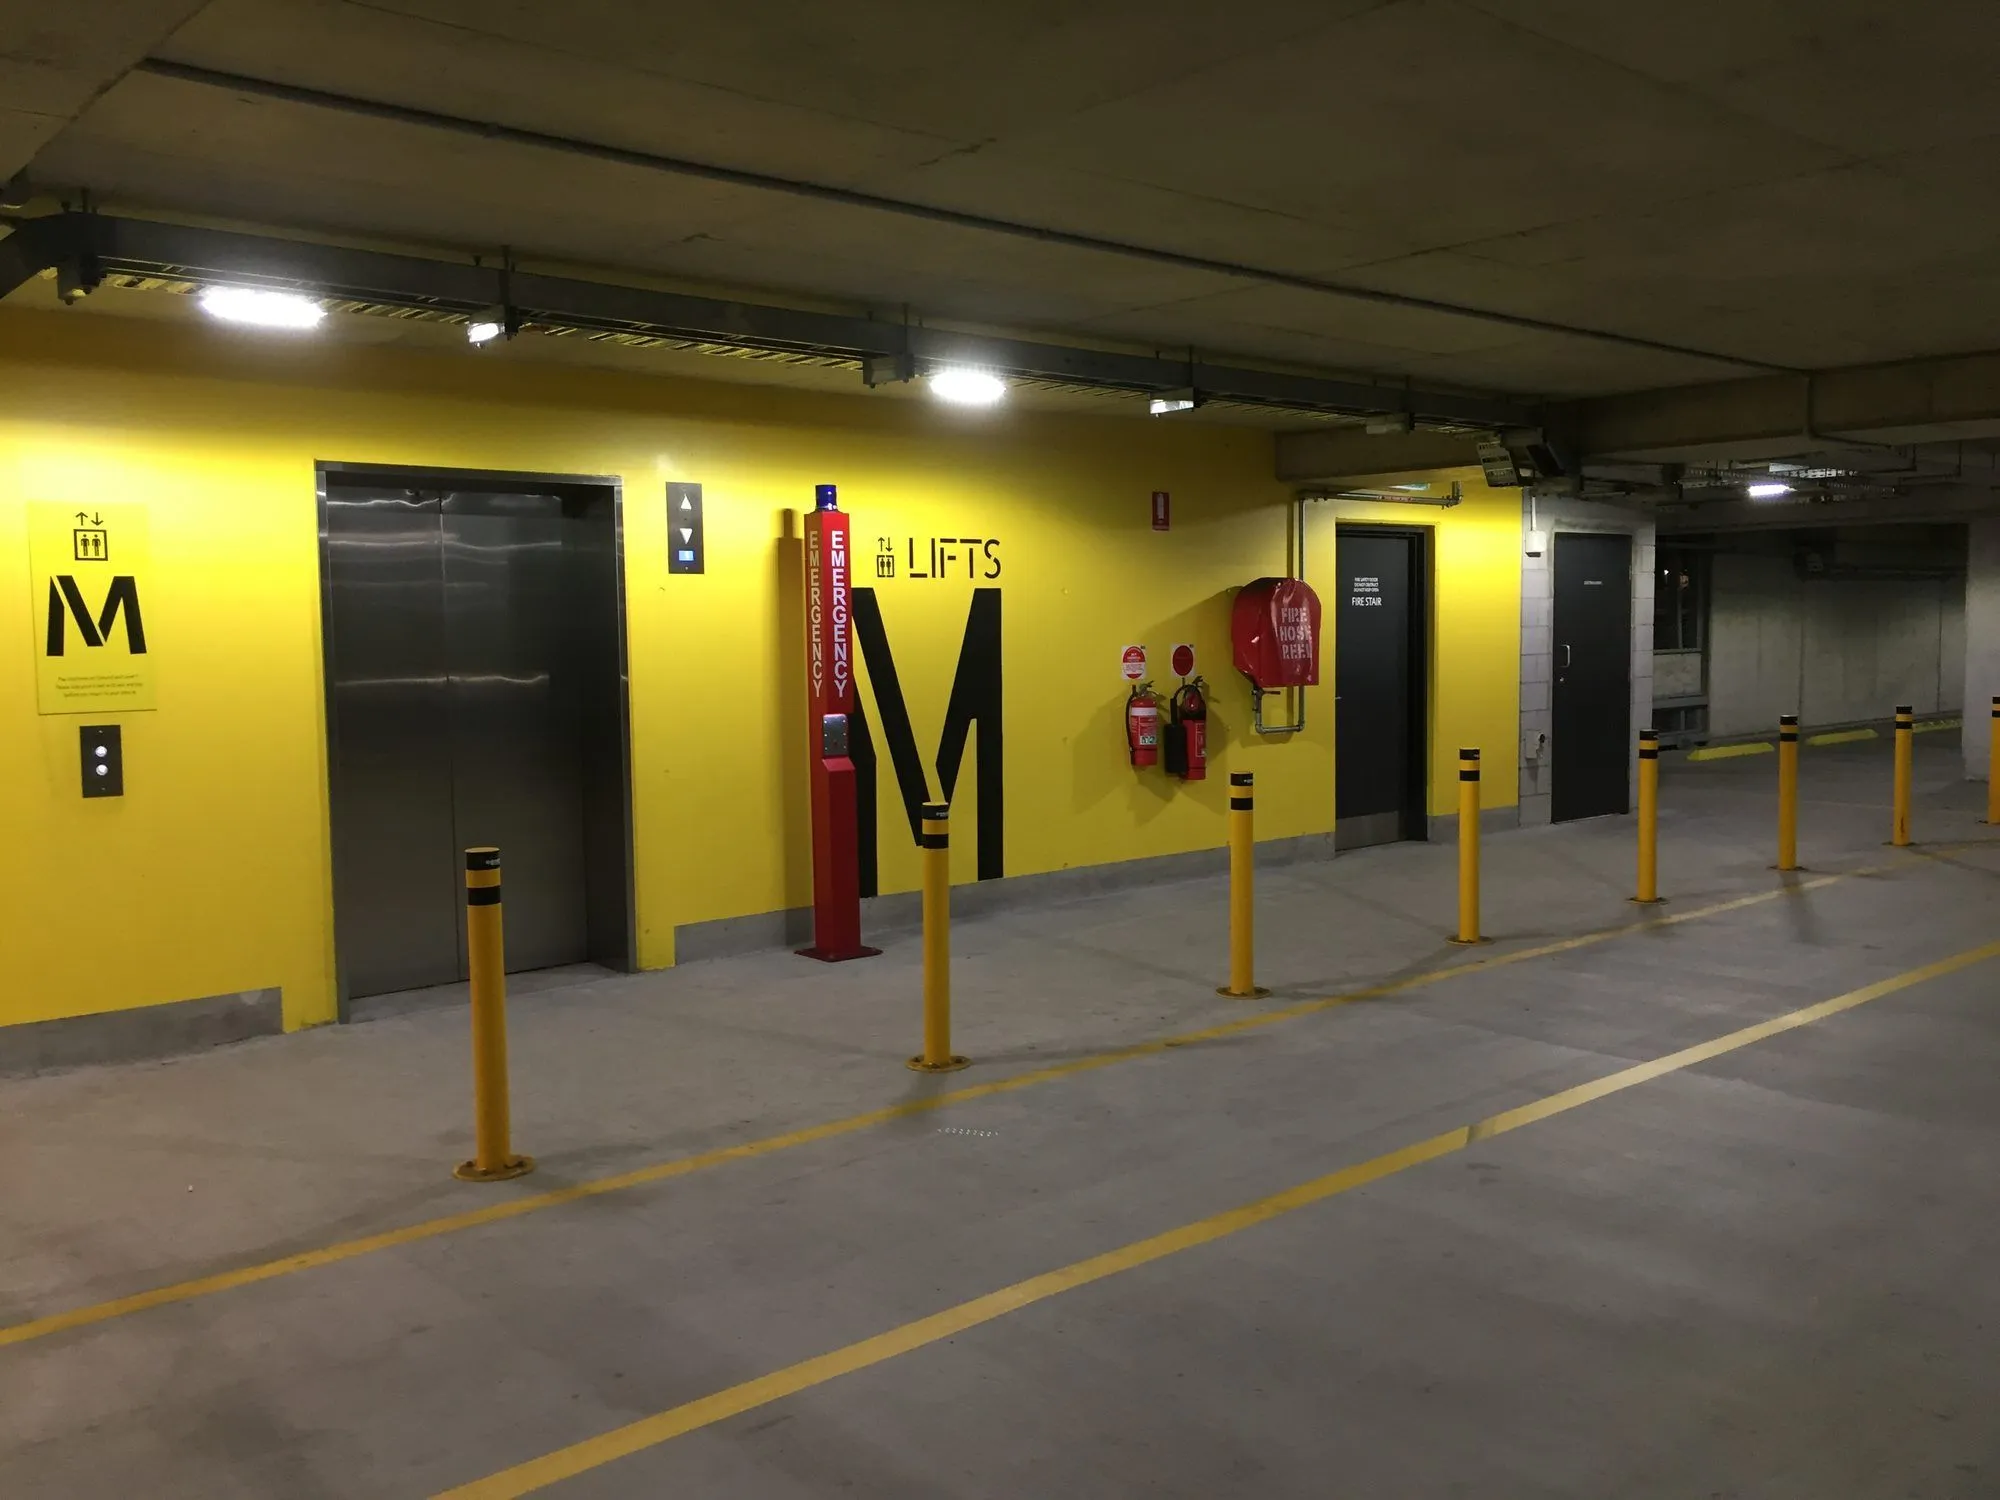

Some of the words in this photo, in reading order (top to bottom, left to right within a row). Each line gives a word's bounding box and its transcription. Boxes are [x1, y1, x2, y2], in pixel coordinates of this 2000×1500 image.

[909, 537, 1001, 579] LIFTS
[46, 575, 147, 657] M
[809, 530, 823, 698] EMERGENCY
[831, 530, 847, 698] EMERGENCY
[1281, 607, 1308, 623] FIRE
[1352, 596, 1365, 606] FIRE
[1365, 596, 1382, 606] STAIR
[850, 587, 1003, 898] M
